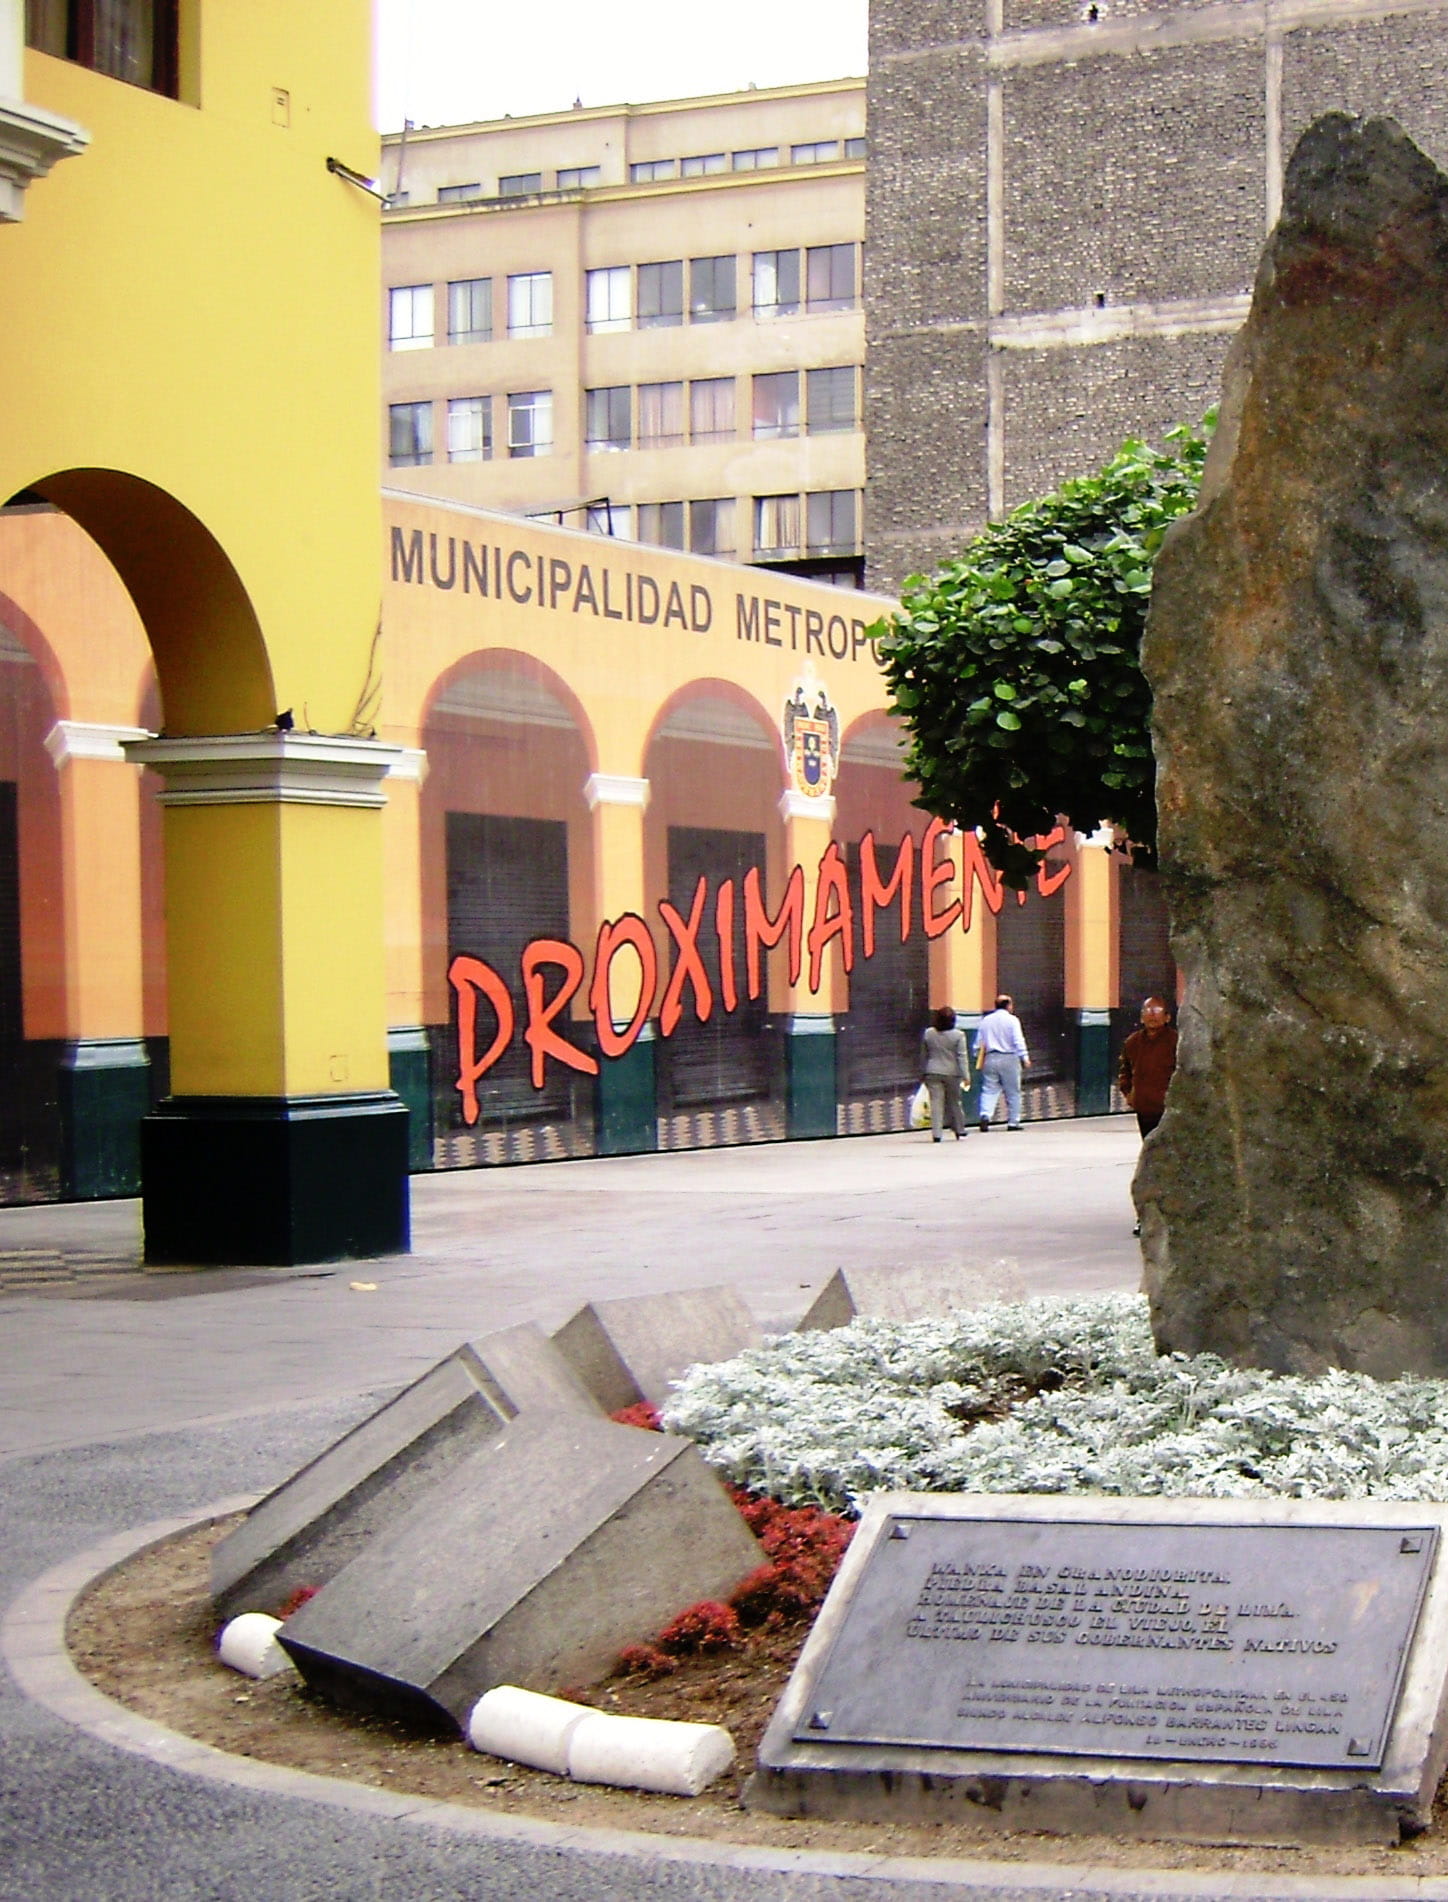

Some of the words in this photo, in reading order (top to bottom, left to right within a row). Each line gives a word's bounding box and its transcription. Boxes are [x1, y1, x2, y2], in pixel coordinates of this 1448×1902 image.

[390, 526, 713, 633] MUNICIPALIDAD
[447, 805, 1074, 1125] PROXIMAMENE
[930, 1563, 1007, 1577] WANKA
[1019, 1565, 1050, 1578] EN
[924, 1577, 1004, 1592] PIEDRA
[1014, 1581, 1088, 1596] BASAL
[917, 1593, 1029, 1609] HOMENAJE
[1035, 1600, 1064, 1610] DE
[1073, 1600, 1103, 1612] LA
[1111, 1599, 1191, 1616] CIUDAD
[1198, 1603, 1229, 1616] DE
[912, 1612, 926, 1622] A
[1089, 1616, 1118, 1629] EL
[1201, 1619, 1229, 1634] EL
[989, 1629, 1019, 1642] DE
[1027, 1630, 1067, 1644] SUS
[1075, 1631, 1234, 1651] GOBERNANTES
[1243, 1637, 1338, 1654] NATIVOS
